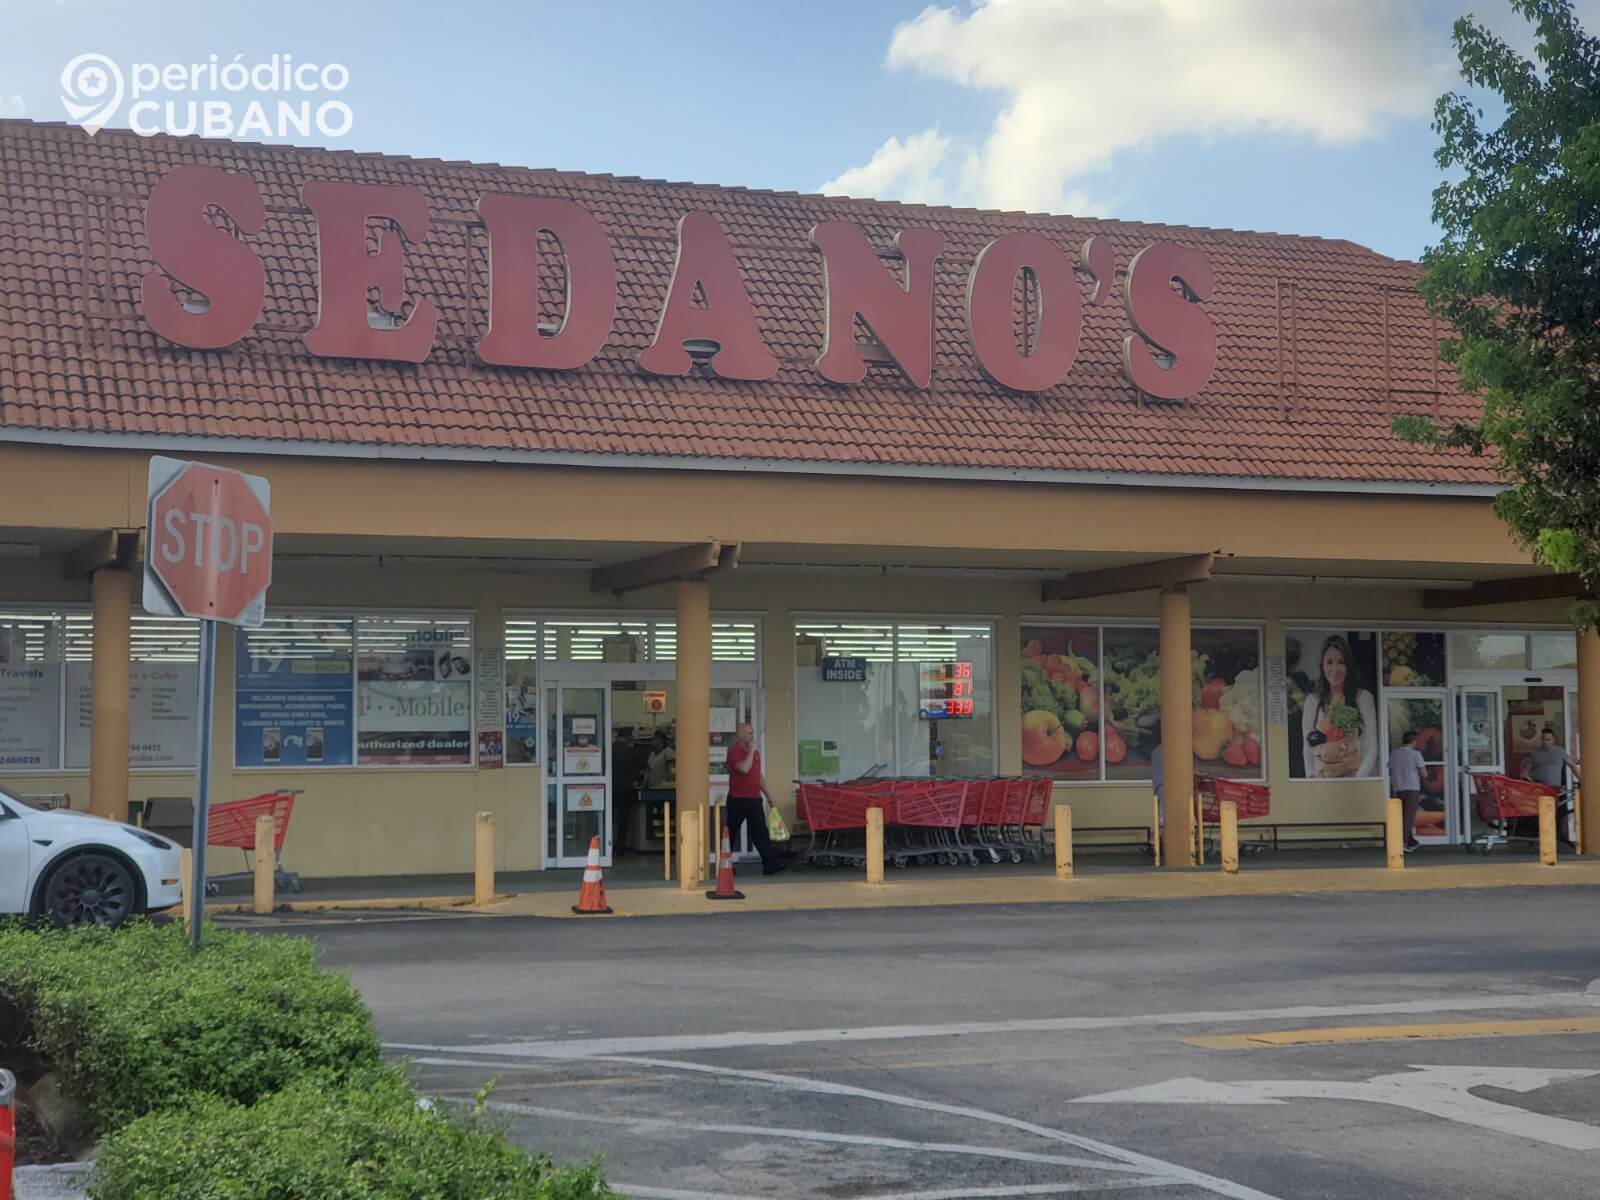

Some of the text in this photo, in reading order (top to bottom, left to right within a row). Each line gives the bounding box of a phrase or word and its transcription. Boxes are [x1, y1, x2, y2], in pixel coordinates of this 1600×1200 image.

[141, 164, 1220, 401] SEDANO'S
[161, 508, 264, 575] STOP
[834, 658, 856, 669] ATM
[826, 669, 863, 681] INSIDE
[953, 664, 970, 678] 36
[396, 695, 465, 718] Mobile
[427, 739, 469, 749] dealer
